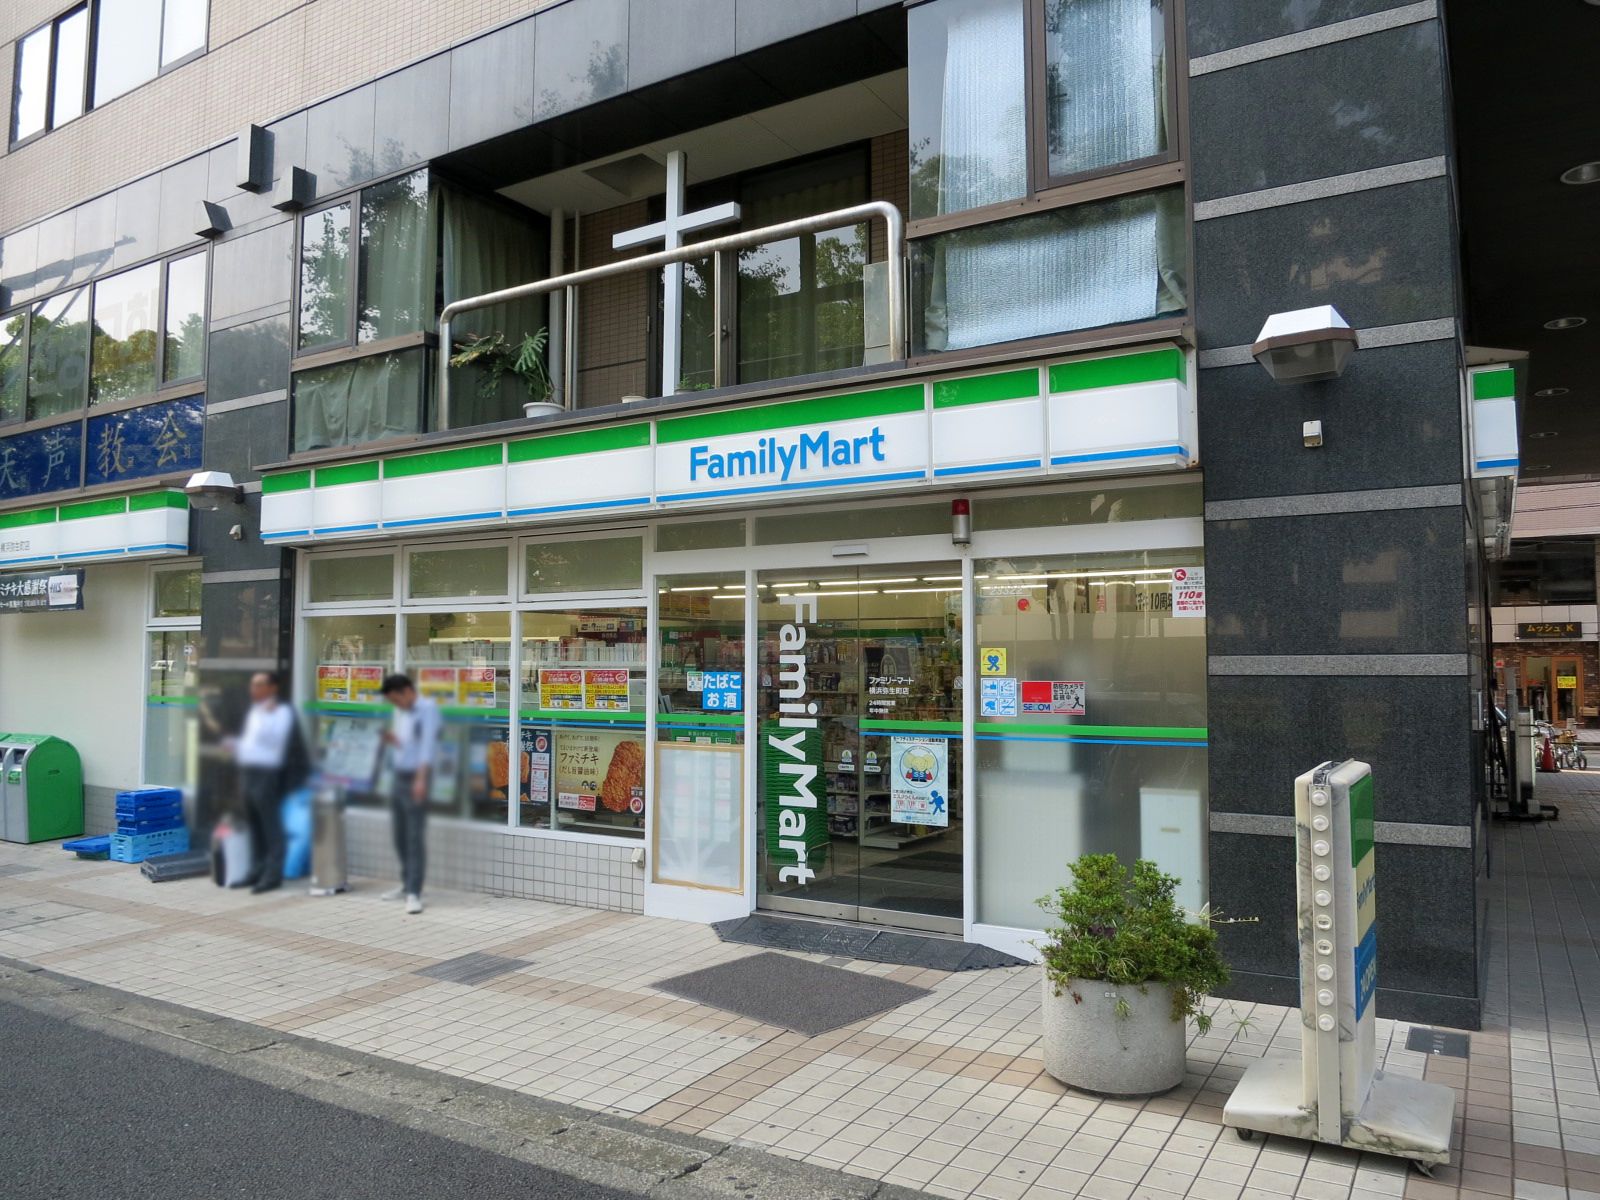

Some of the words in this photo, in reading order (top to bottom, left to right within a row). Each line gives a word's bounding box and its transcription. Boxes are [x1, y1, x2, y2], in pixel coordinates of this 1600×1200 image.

[690, 426, 885, 481] FamilyMart
[703, 674, 742, 689] たばこ
[868, 676, 915, 685] ファミリーマート
[707, 692, 737, 708] お酒
[1023, 703, 1051, 711] SECOM
[768, 595, 818, 885] FamilyMart
[560, 752, 600, 765] ファミチキ
